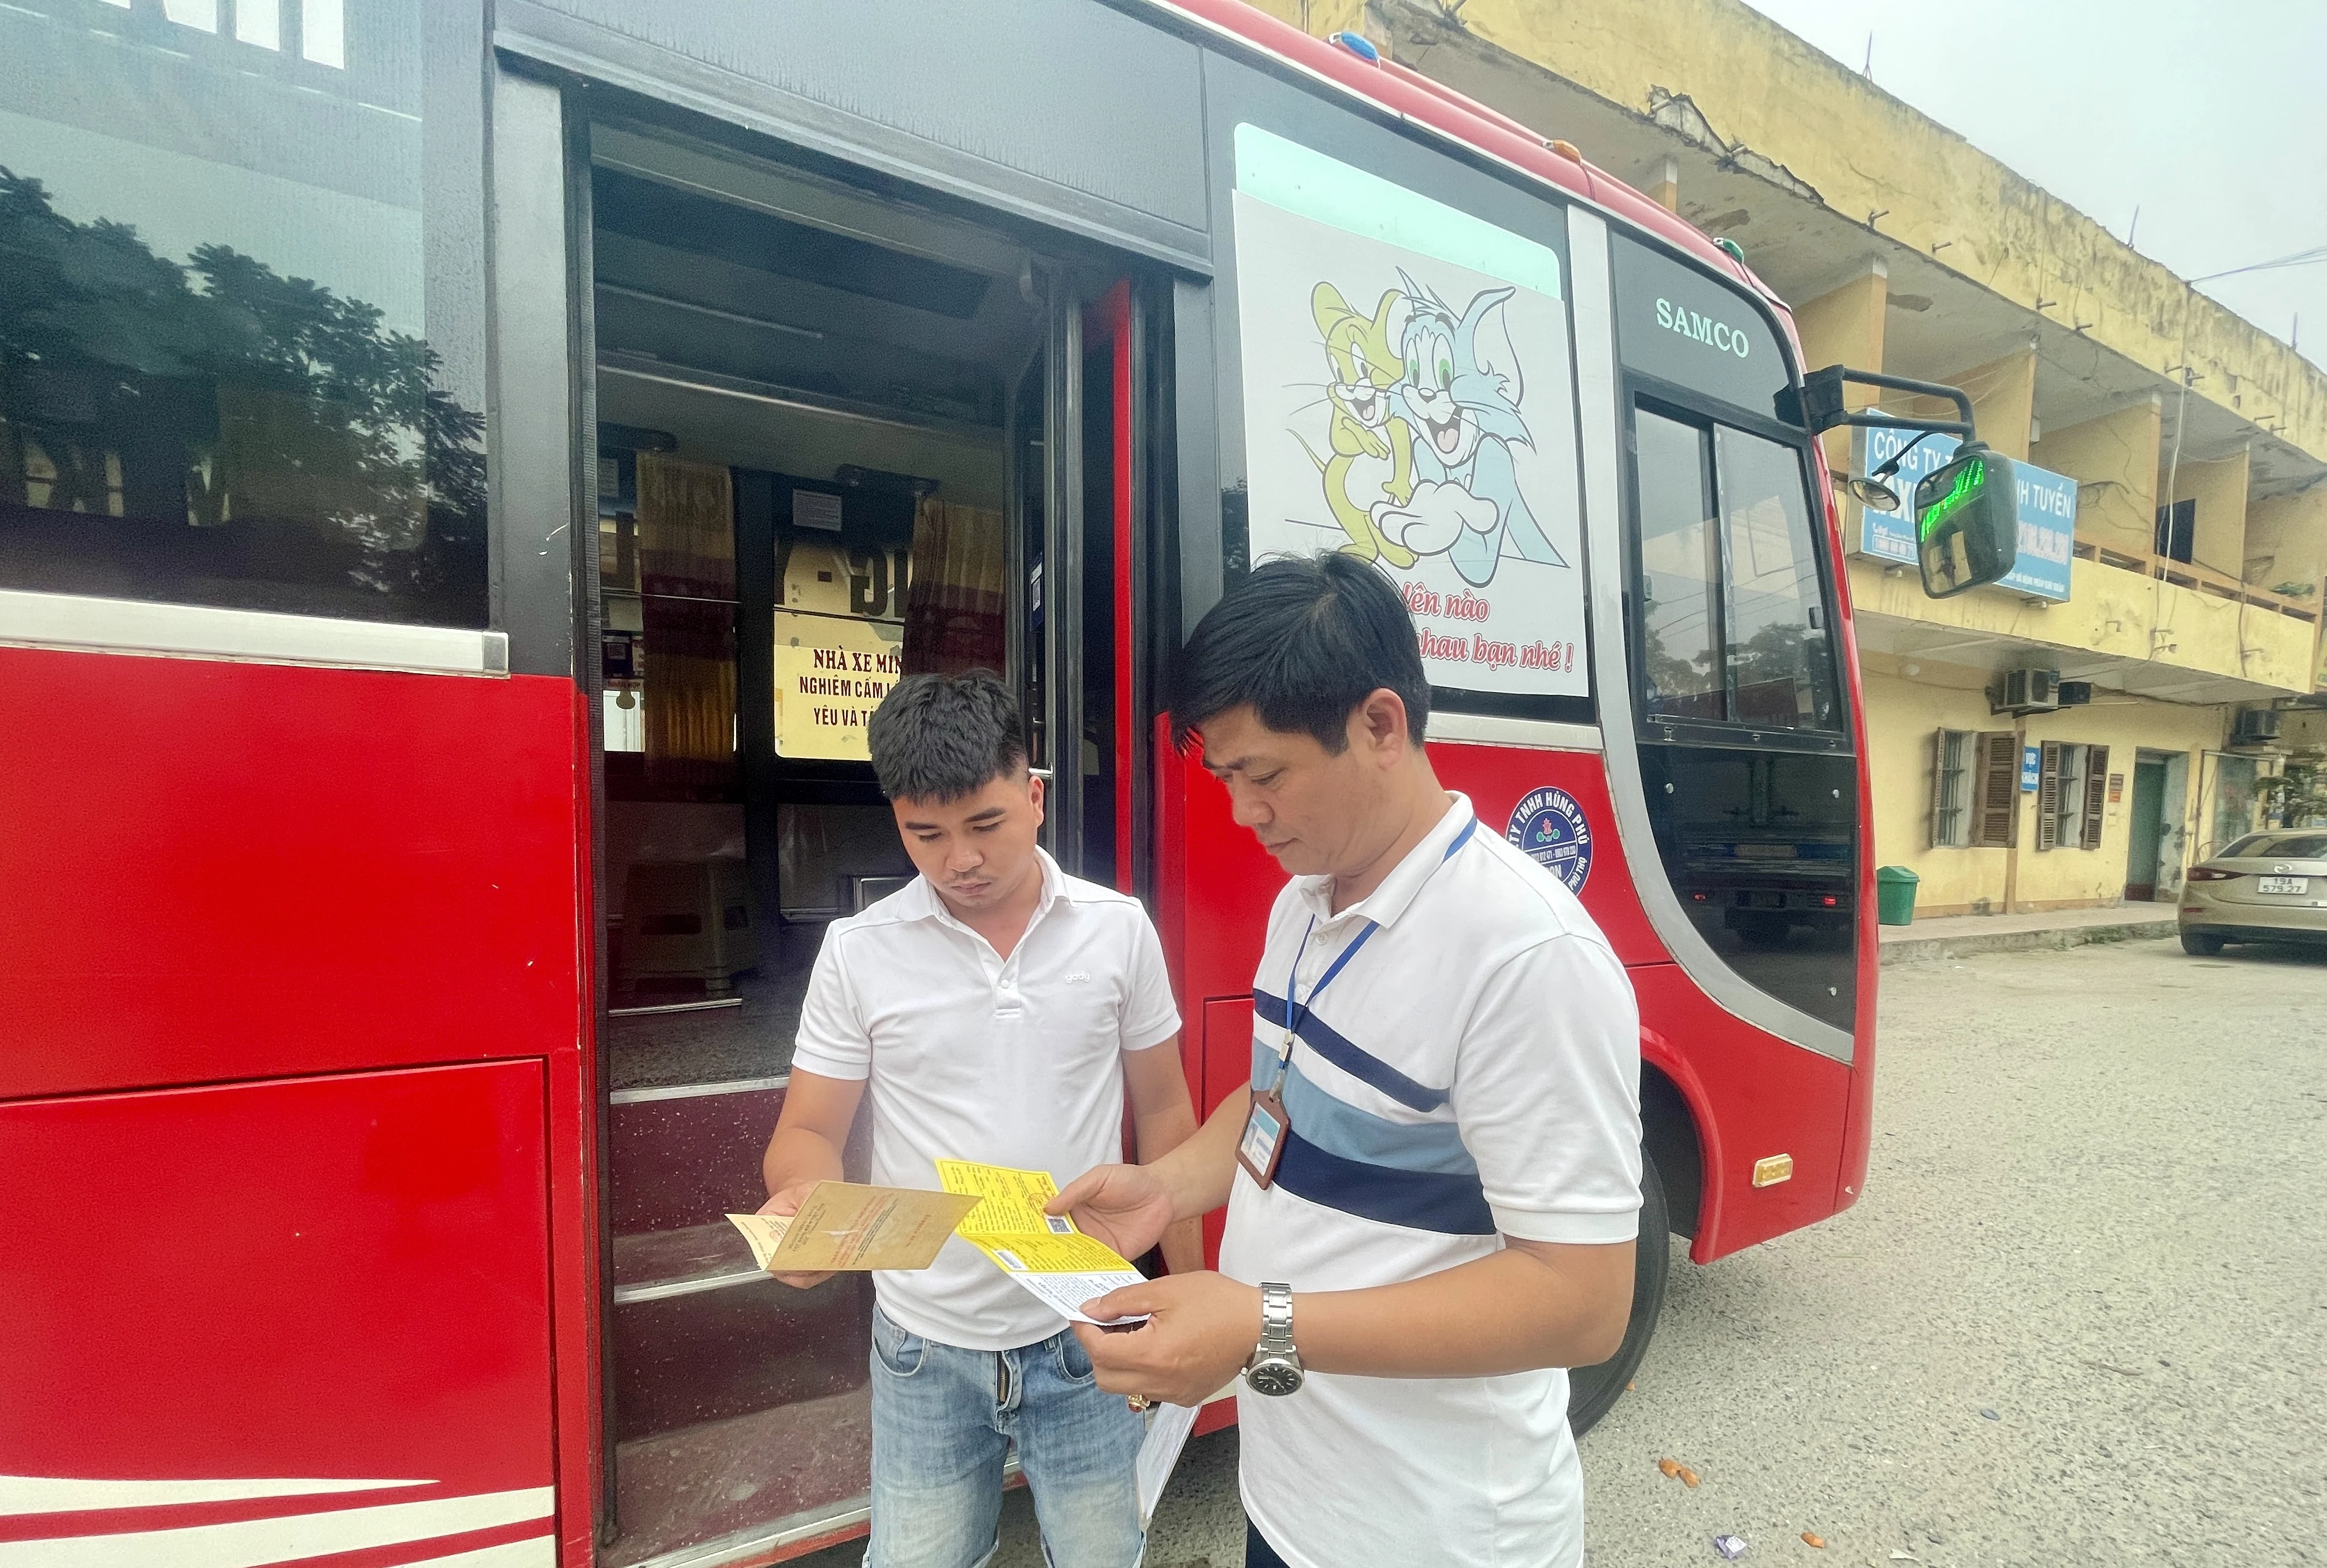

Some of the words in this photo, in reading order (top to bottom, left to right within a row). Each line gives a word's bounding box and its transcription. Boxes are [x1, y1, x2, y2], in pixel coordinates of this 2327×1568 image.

[1656, 298, 1750, 358] SAMCO
[1874, 428, 1918, 470] CÔNG
[1923, 448, 1941, 474] TY
[2033, 482, 2071, 518] TUYẾN
[1443, 588, 1490, 622] nào
[813, 645, 847, 671] NHÀ
[852, 653, 872, 672] XE
[1471, 633, 1518, 671] bạn
[1519, 640, 1562, 671] nhé
[800, 674, 851, 697] NGHIÊM
[855, 676, 884, 698] CẤM
[814, 704, 838, 726] YÊU
[841, 706, 858, 726] VÀ
[1515, 793, 1543, 824] TNHH
